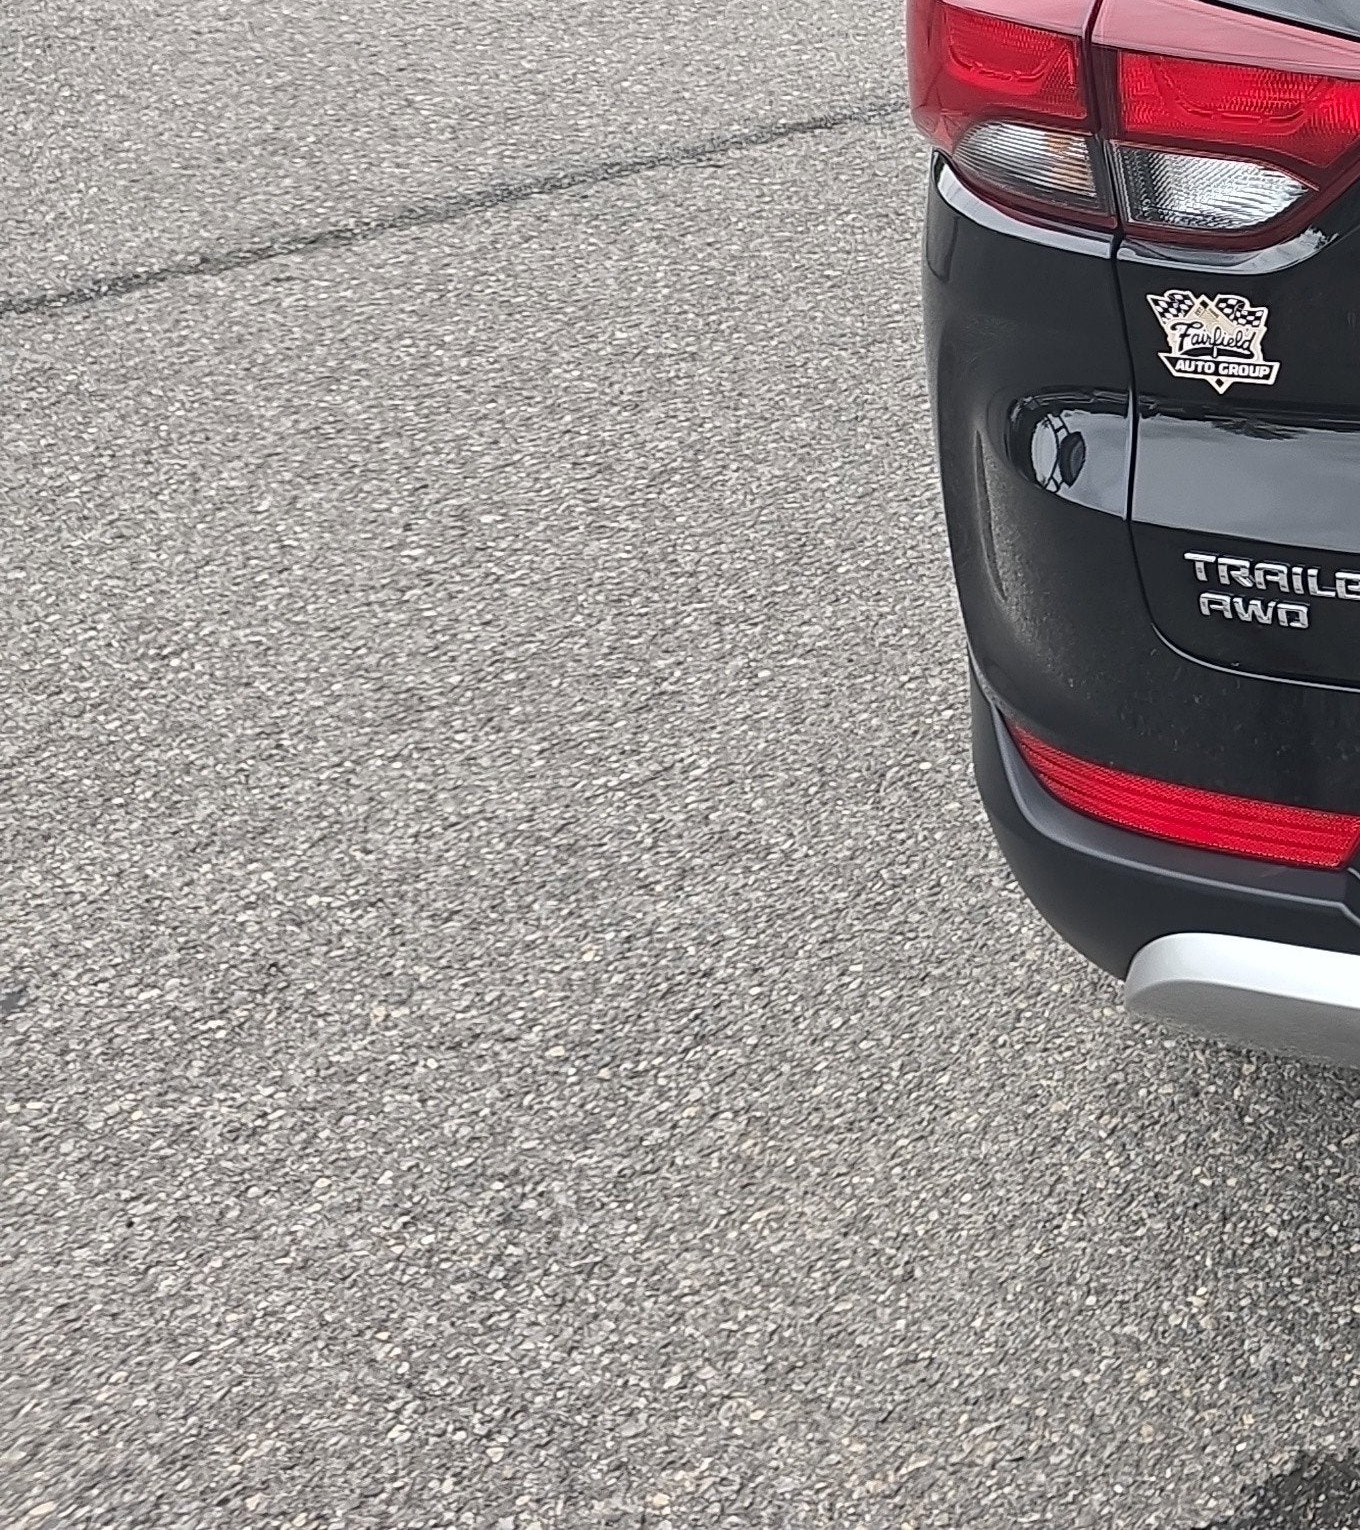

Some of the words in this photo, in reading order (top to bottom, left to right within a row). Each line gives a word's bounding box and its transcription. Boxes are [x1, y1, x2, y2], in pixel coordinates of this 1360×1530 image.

[1170, 321, 1257, 357] Fairfield
[1174, 359, 1216, 374] AUTO
[1218, 362, 1271, 378] GROUP
[1199, 590, 1310, 629] AWD
